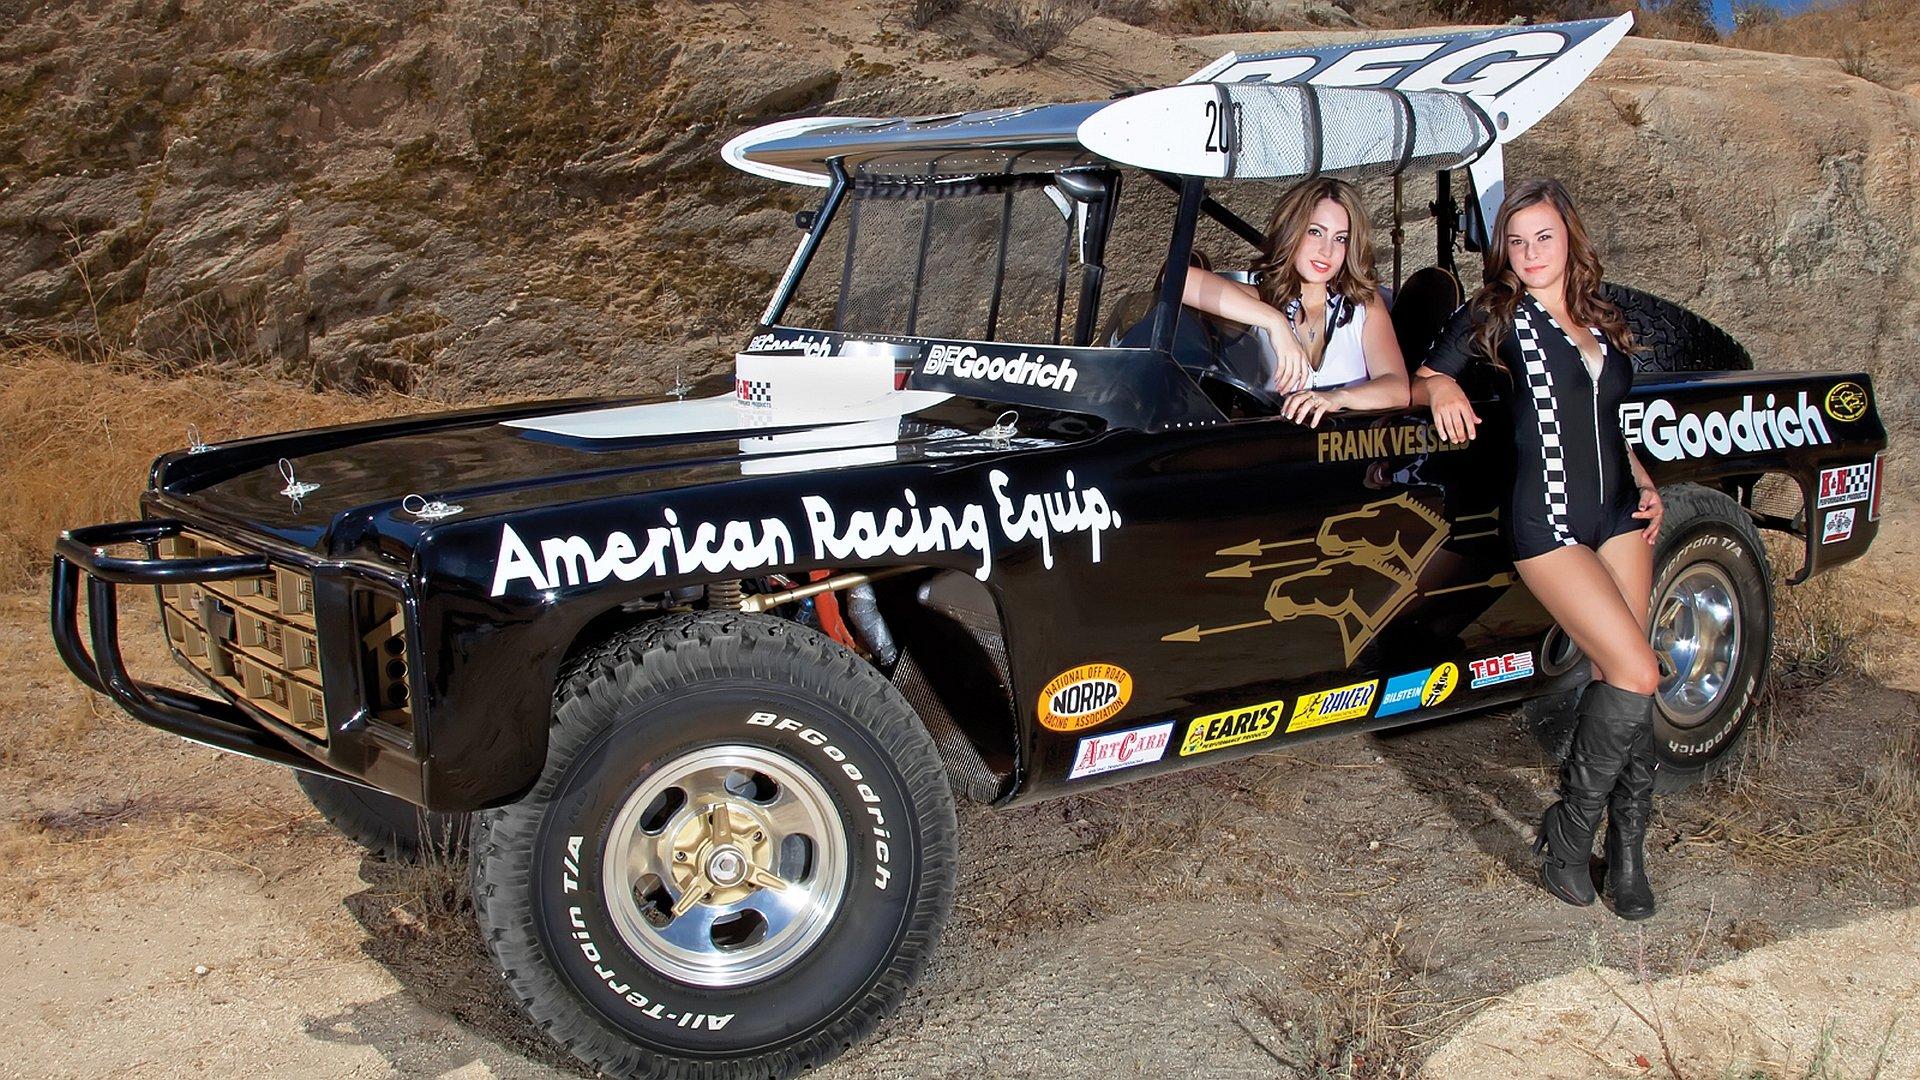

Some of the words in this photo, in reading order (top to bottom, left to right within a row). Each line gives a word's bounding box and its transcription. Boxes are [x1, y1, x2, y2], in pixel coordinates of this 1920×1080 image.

[922, 344, 1079, 392] BFGoodrich
[1318, 428, 1388, 463] FRANK
[491, 507, 795, 597] American
[801, 488, 992, 581] Racing
[988, 469, 1122, 570] Equip.
[1045, 667, 1084, 698] NATIONAL
[1088, 666, 1103, 679] OFF
[1105, 667, 1127, 684] ROAD
[1053, 682, 1118, 714] NORRA
[1319, 684, 1375, 715] BAKER
[1384, 685, 1423, 705] BILSTEIN
[1043, 712, 1069, 729] RACING
[1074, 697, 1125, 728] ASSOCIATION
[1204, 705, 1279, 742] EARL'S
[745, 711, 892, 890] BFGoodrich
[562, 835, 585, 895] T/A
[568, 906, 736, 1031] All-Terrain
